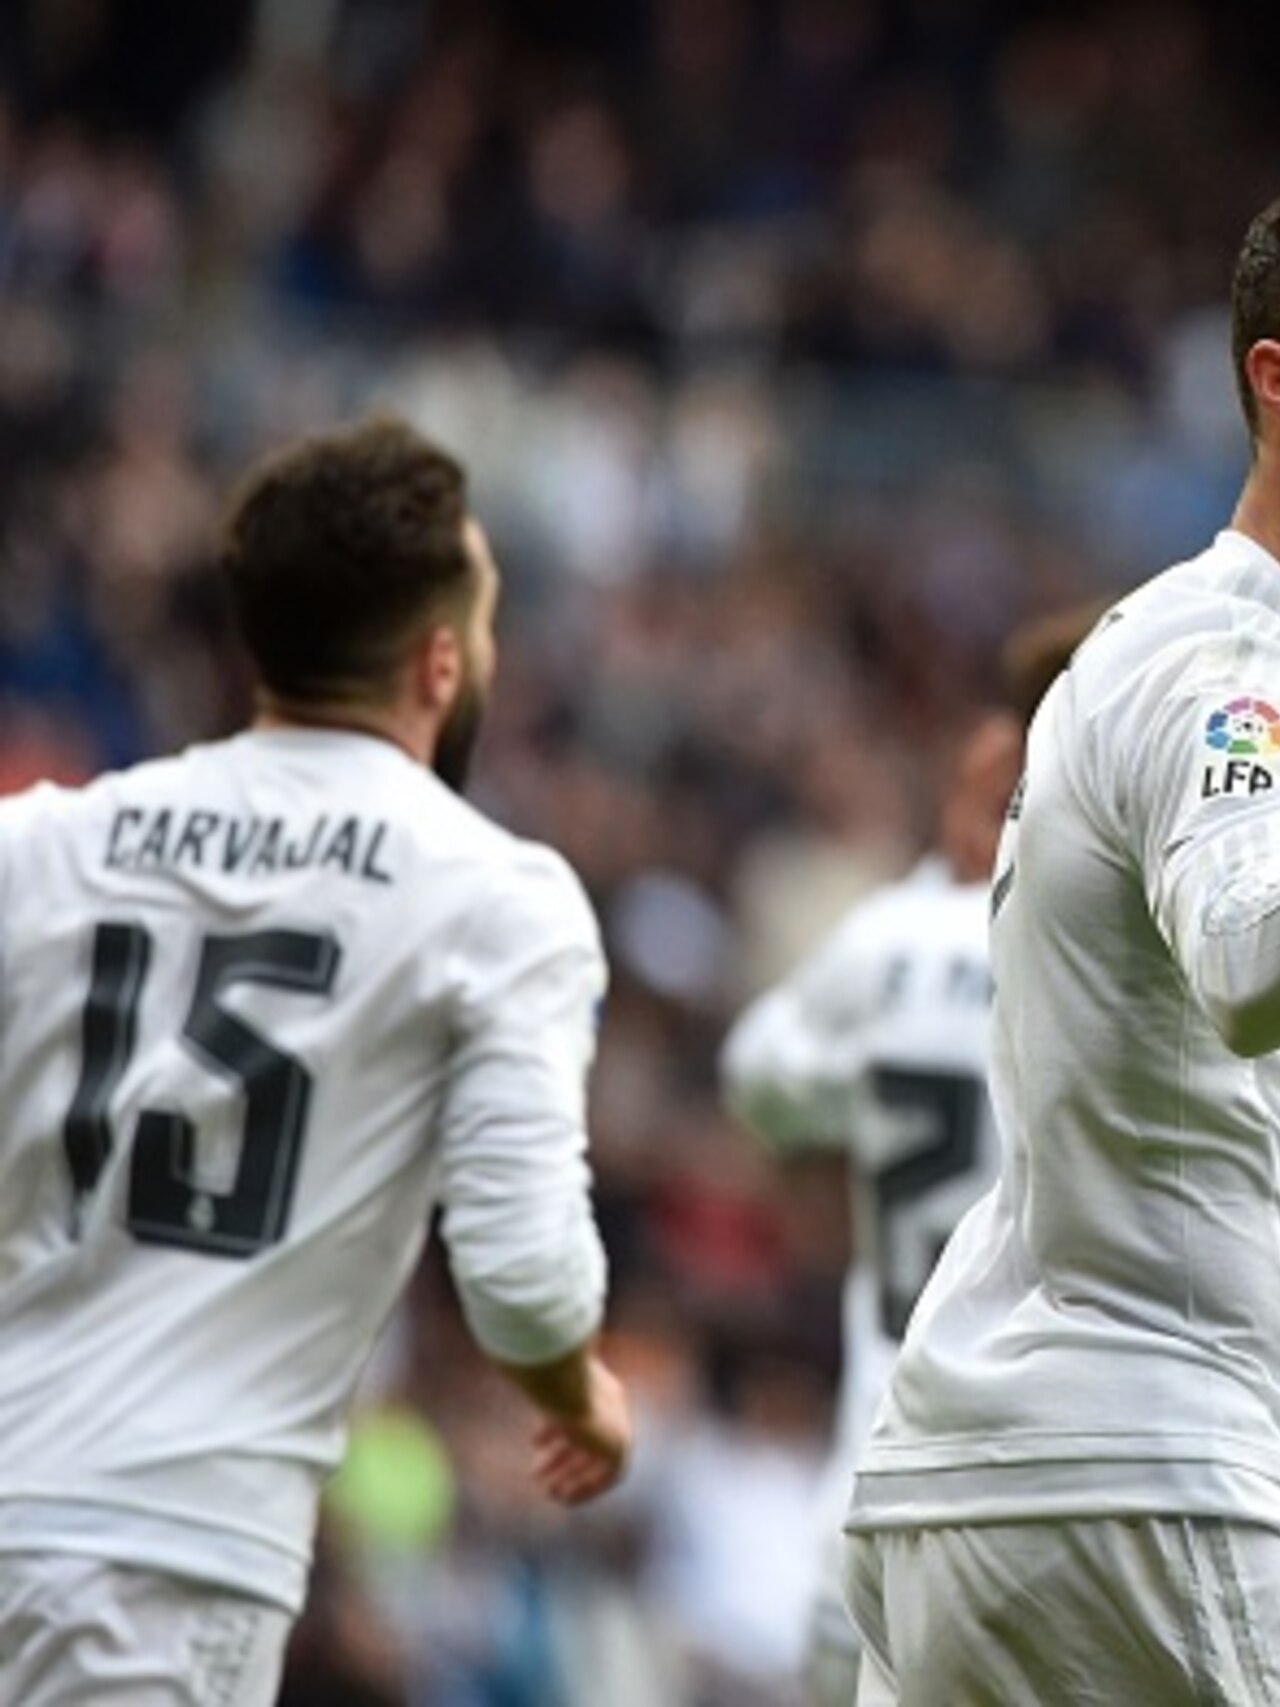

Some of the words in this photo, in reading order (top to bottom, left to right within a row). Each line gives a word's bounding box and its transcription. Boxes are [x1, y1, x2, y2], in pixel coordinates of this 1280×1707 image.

[1202, 761, 1272, 798] LFP
[106, 808, 391, 884] CARVAJAL
[64, 921, 341, 1258] 15
